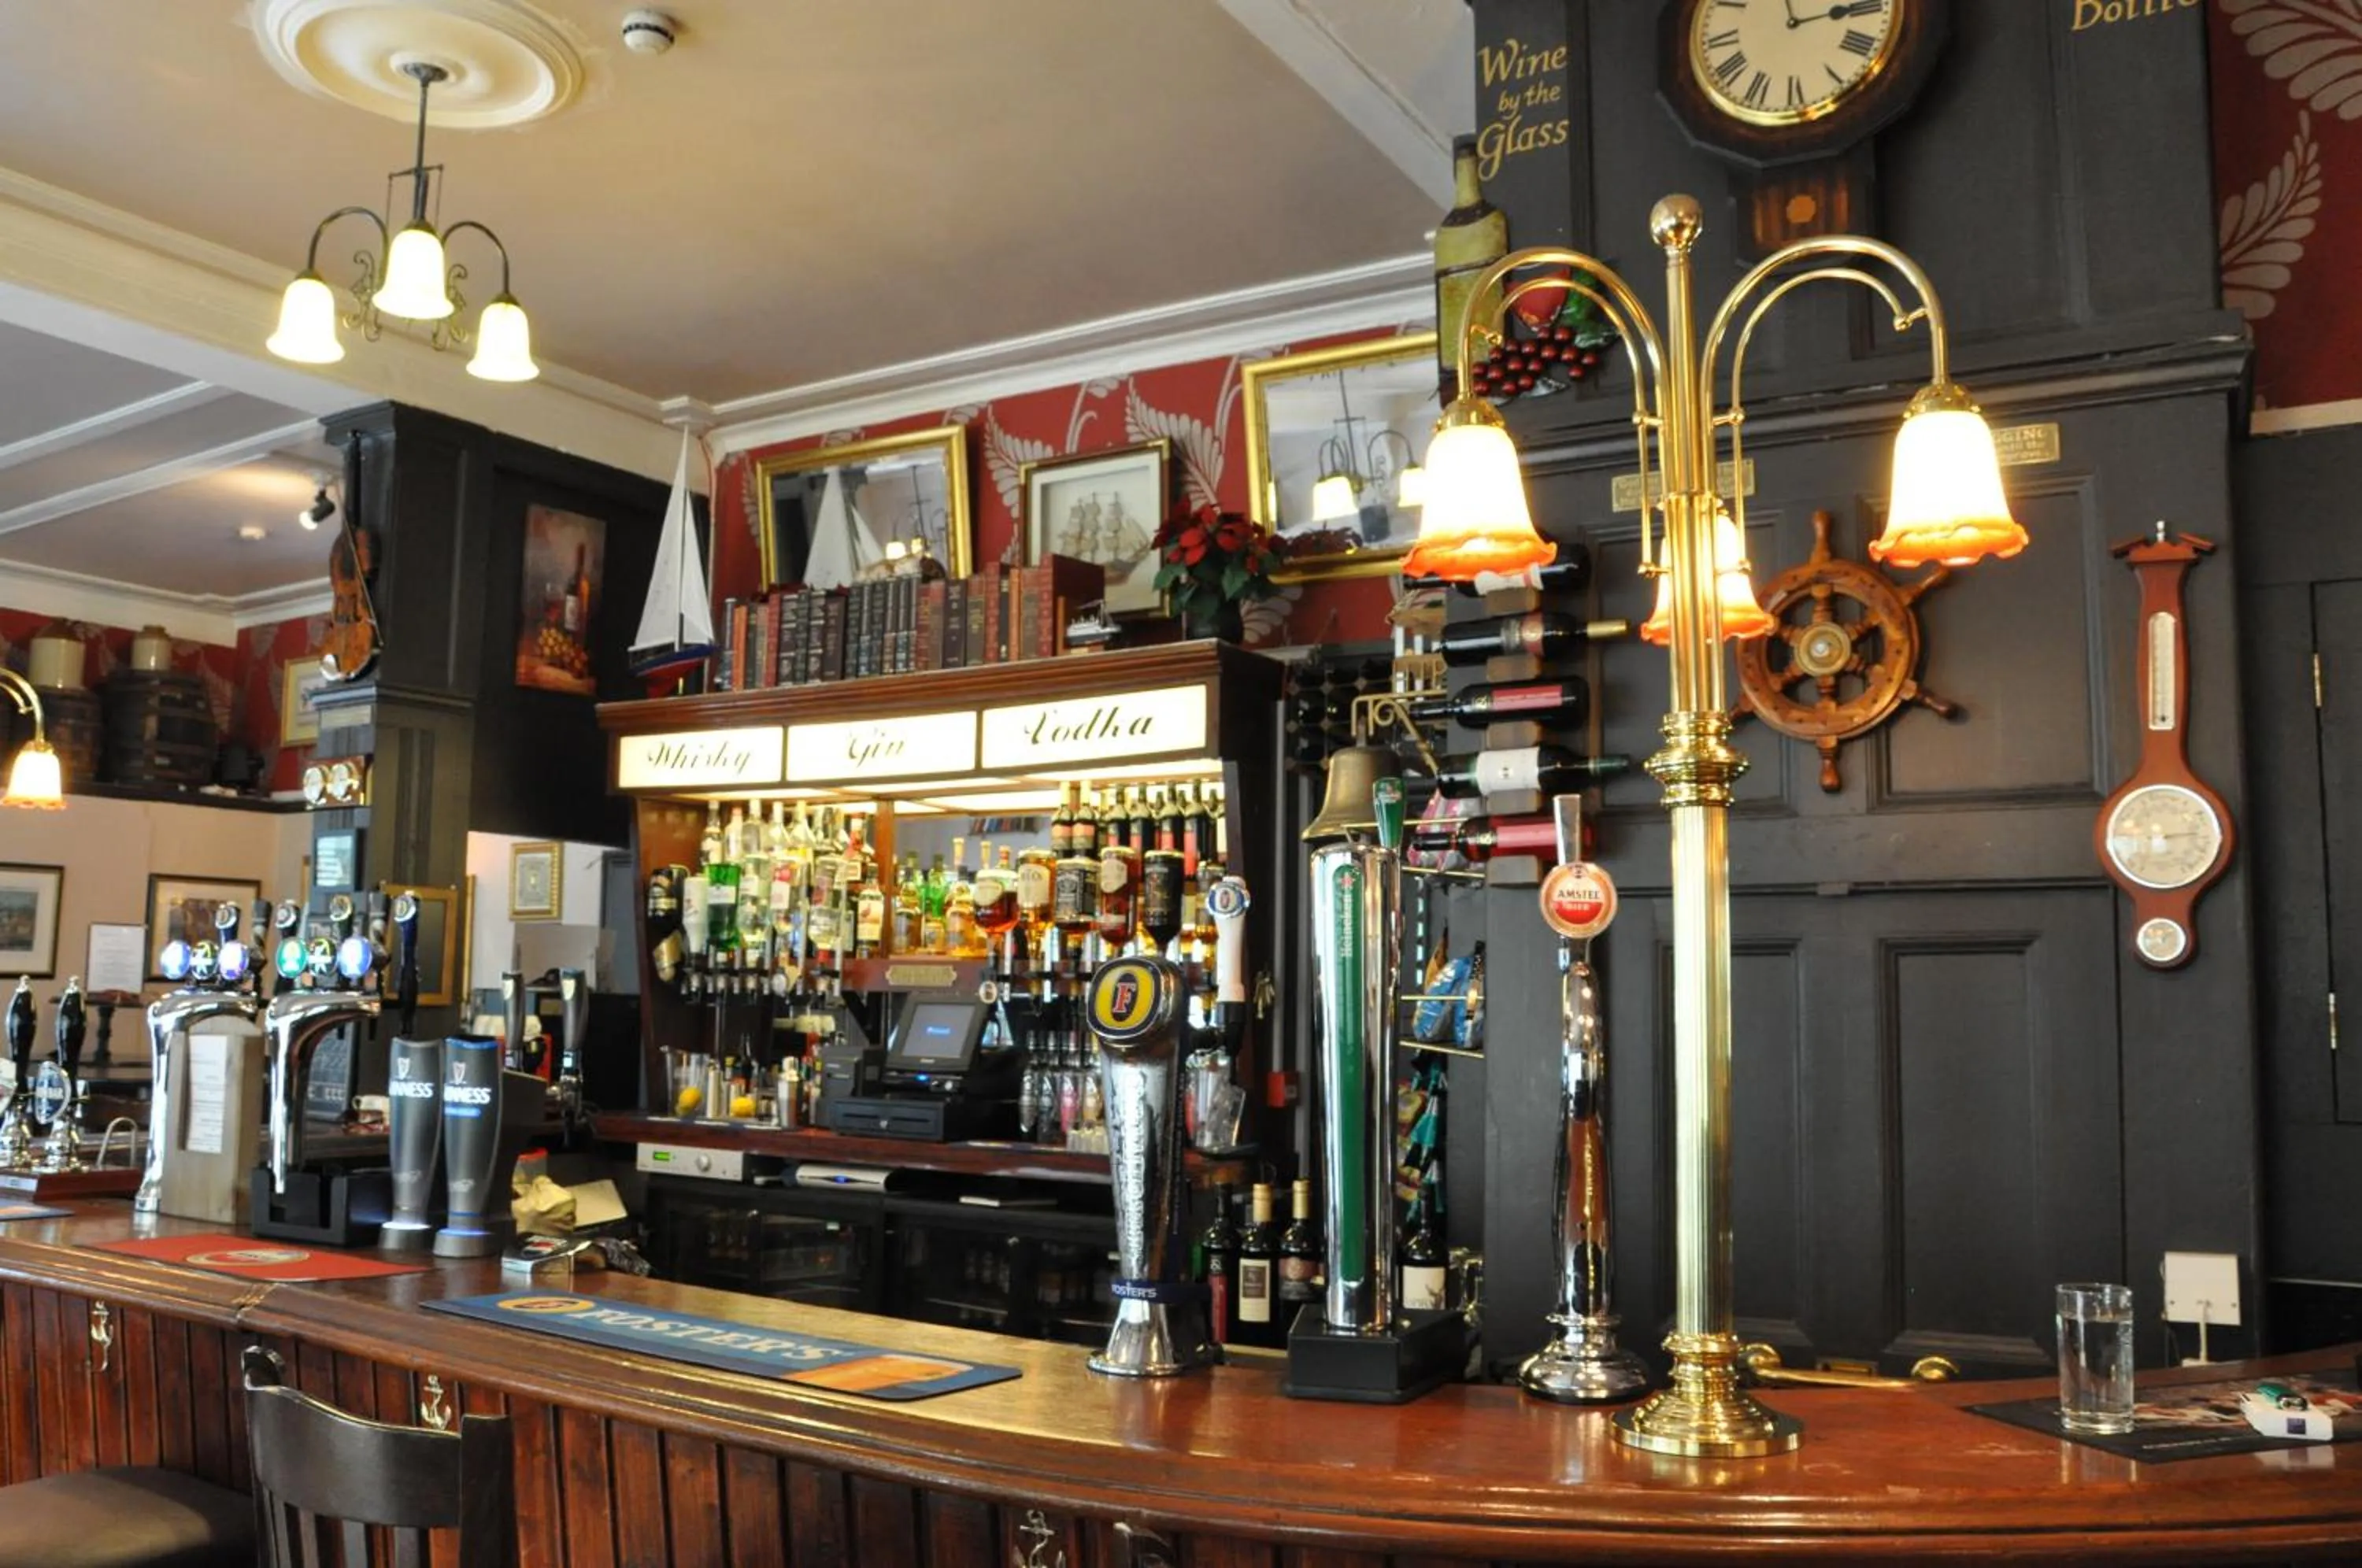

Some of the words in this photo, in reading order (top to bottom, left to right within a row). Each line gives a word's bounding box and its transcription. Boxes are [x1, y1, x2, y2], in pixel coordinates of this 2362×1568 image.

[2071, 0, 2197, 30] Bot
[1477, 39, 1568, 87] Wine
[1498, 91, 1521, 120] by
[1523, 80, 1561, 107] the
[1477, 115, 1570, 181] Glass
[1557, 889, 1601, 900] AMSTEL
[1112, 982, 1138, 1014] F
[389, 1081, 435, 1098] INNESS
[443, 1085, 492, 1105] INNESS
[565, 1307, 842, 1362] FOSTER'S
